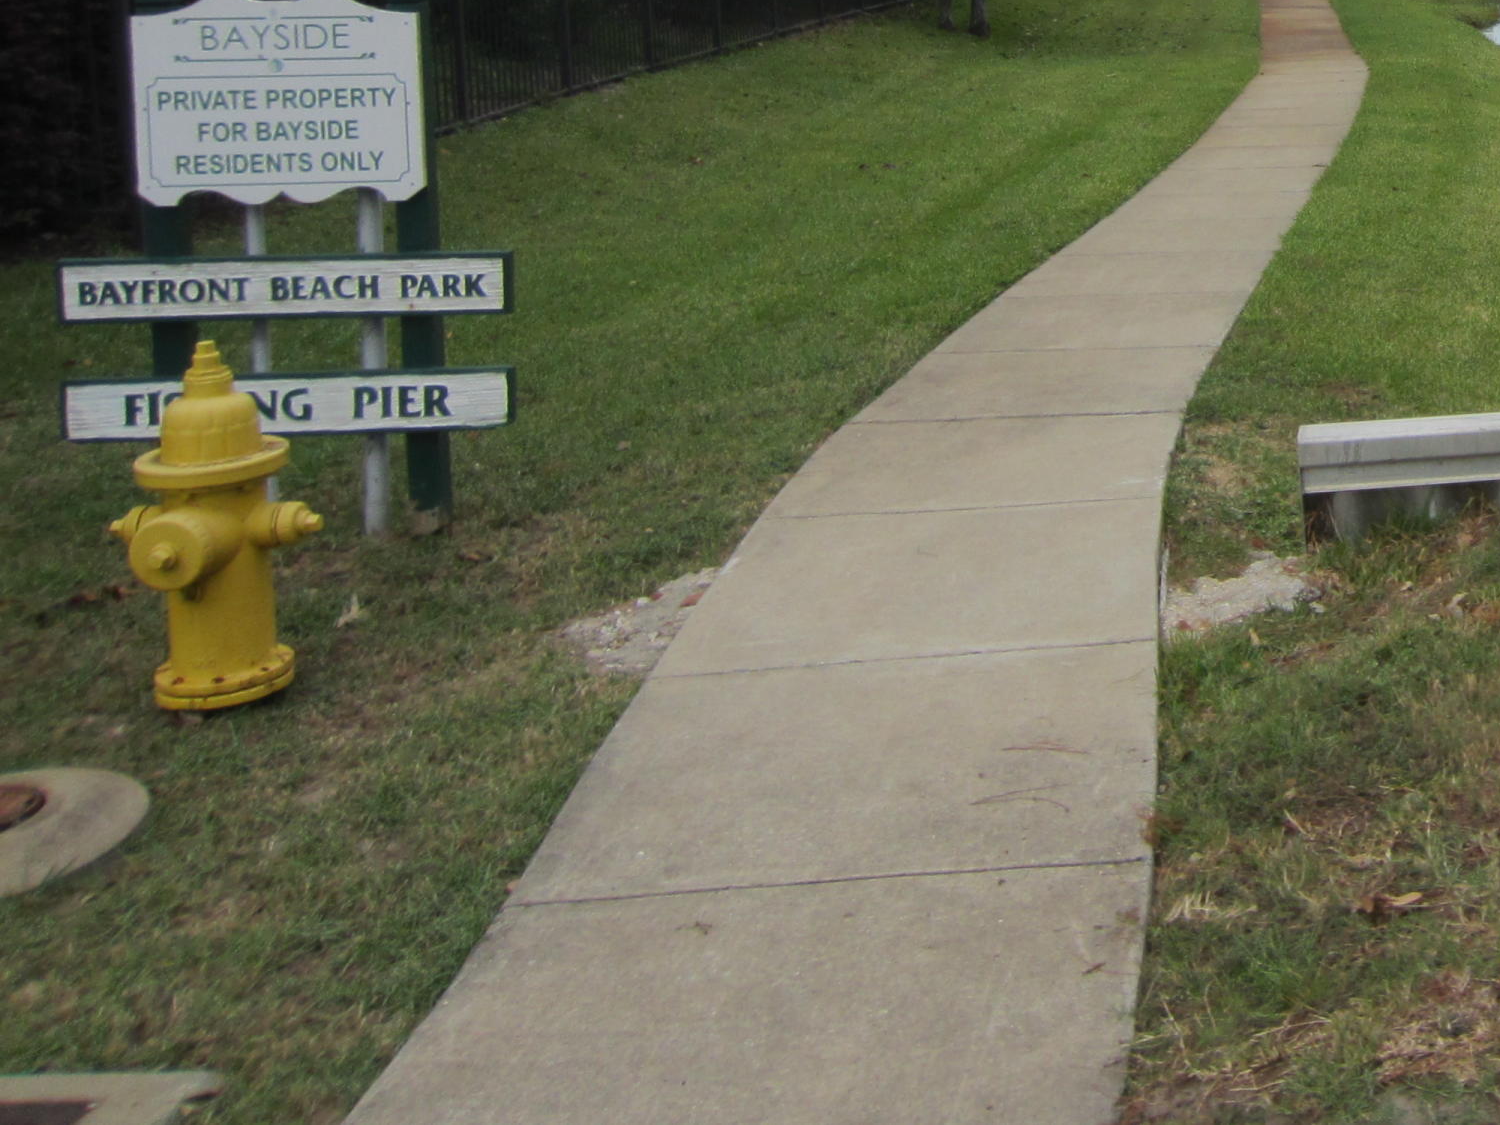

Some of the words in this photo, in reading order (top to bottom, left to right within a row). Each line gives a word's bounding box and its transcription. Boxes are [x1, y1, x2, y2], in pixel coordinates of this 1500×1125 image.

[200, 23, 350, 51] BAYSIDE
[157, 90, 257, 112] PRIVATE
[265, 87, 396, 109] PROPERTY
[197, 122, 248, 142] FOR
[256, 120, 359, 141] BAYSIDE
[176, 152, 313, 175] RESIDENTS
[321, 151, 384, 171] ONLY
[78, 277, 250, 306] BAYFRONT
[270, 275, 380, 302] BEACH
[400, 274, 487, 298] PARK
[124, 388, 313, 427] FING
[353, 385, 453, 419] PIER
